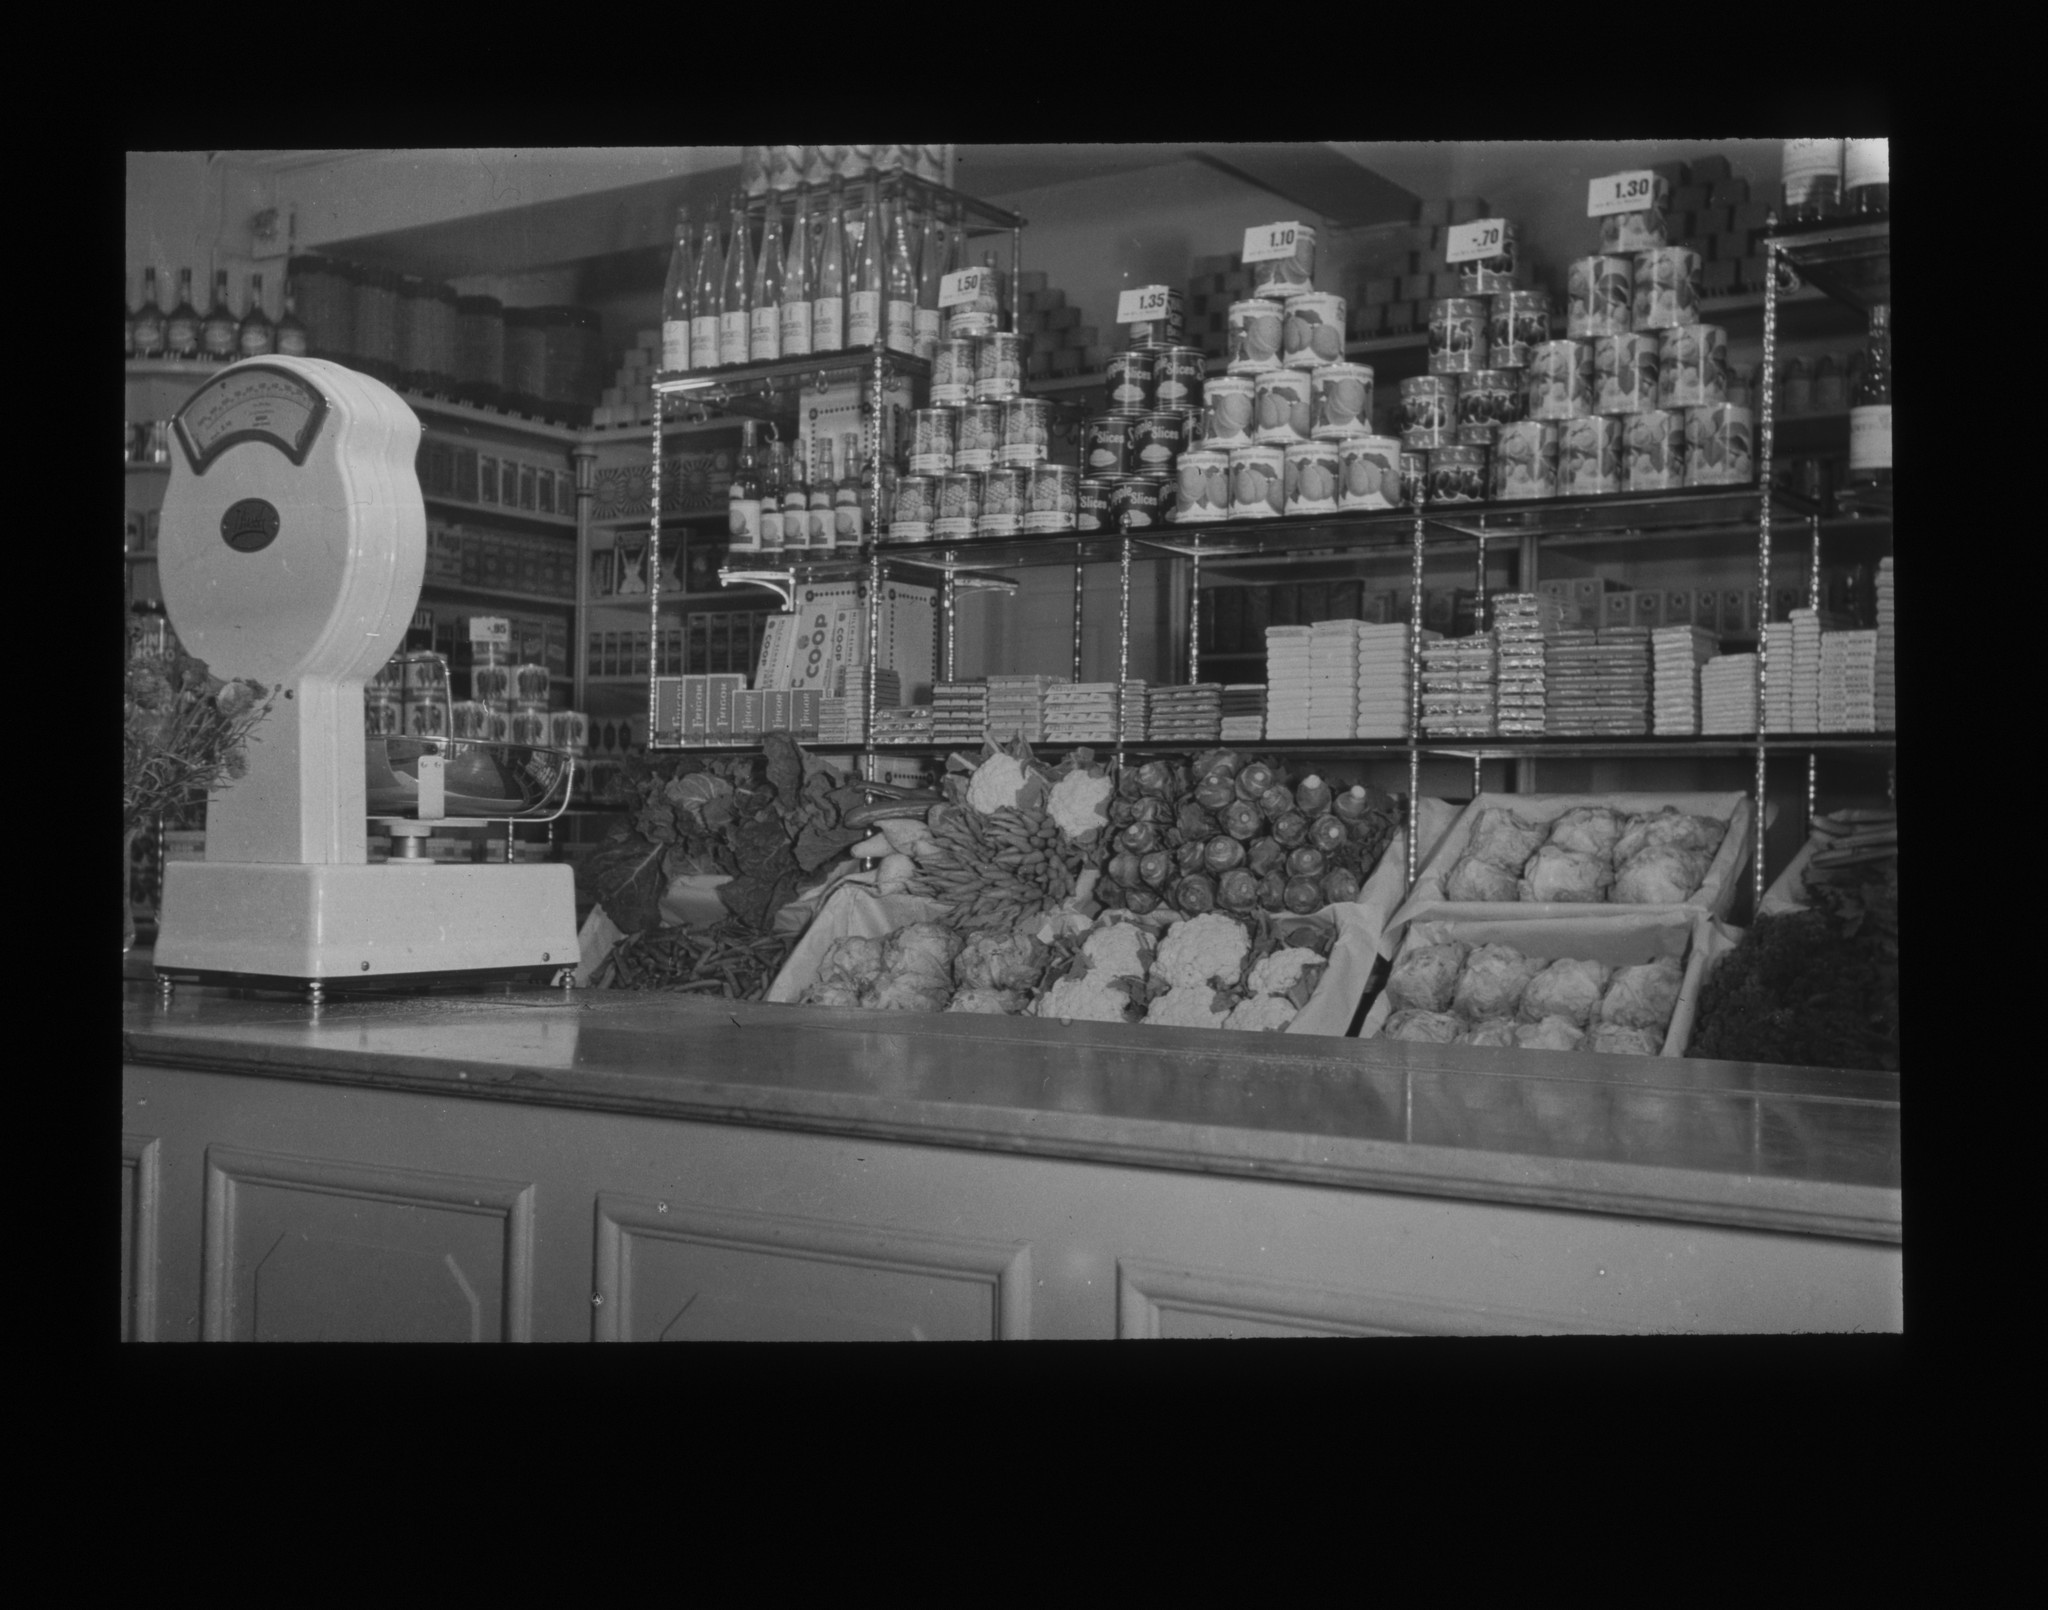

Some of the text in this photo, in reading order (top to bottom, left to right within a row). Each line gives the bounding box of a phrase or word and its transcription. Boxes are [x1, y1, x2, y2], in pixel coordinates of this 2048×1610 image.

[1615, 178, 1649, 199] 1.30
[1270, 229, 1295, 247] 1.10
[957, 274, 978, 292] 1.50
[1139, 293, 1166, 309] 1.35
[1097, 431, 1124, 444] Slices
[1151, 425, 1179, 440] Slices
[1080, 496, 1107, 509] Slices
[1130, 492, 1157, 506] Slices
[762, 634, 772, 666] COOP
[806, 614, 828, 678] COOP
[836, 628, 844, 661] COOP
